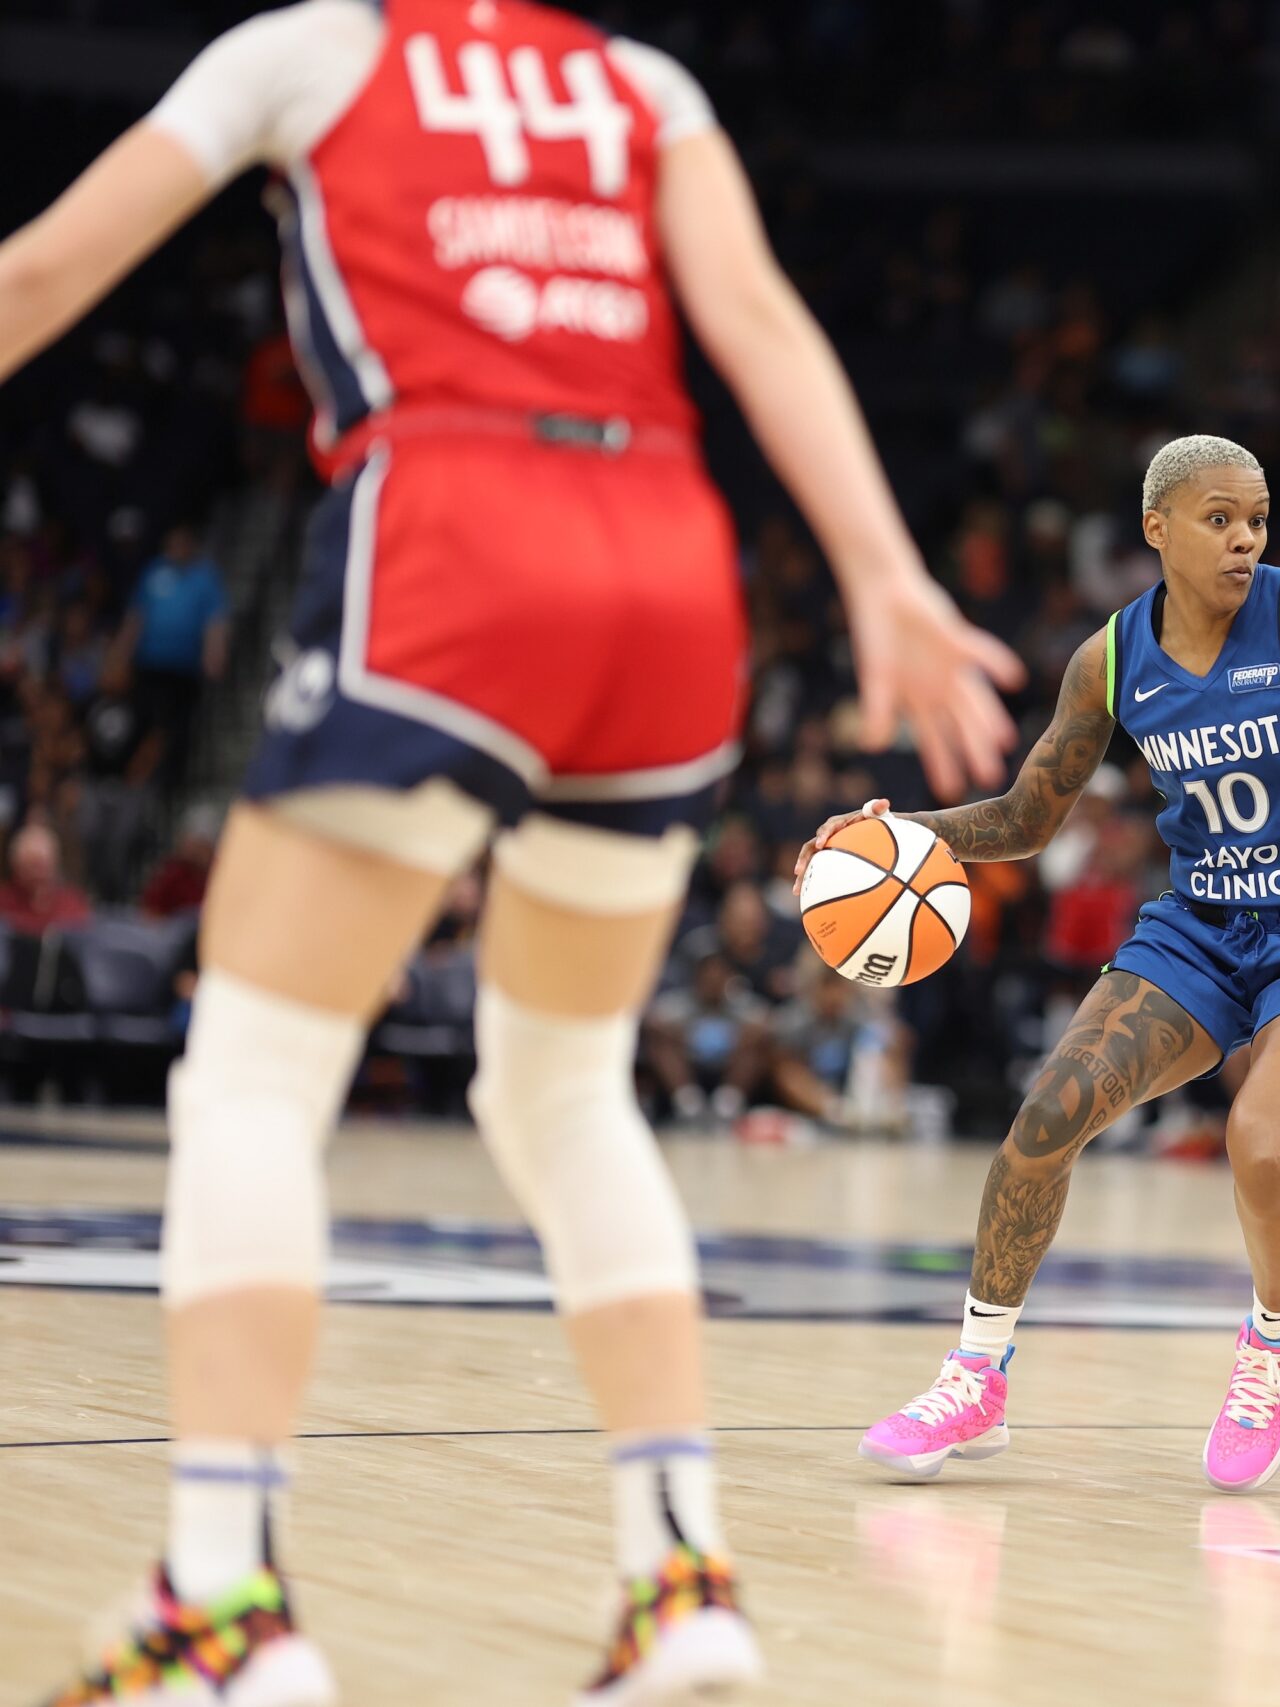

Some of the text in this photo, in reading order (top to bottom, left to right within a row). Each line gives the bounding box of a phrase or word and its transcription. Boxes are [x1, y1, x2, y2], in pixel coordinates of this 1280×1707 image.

[403, 33, 633, 199] 44
[1232, 666, 1278, 681] FEDERATED
[1183, 771, 1270, 834] 10
